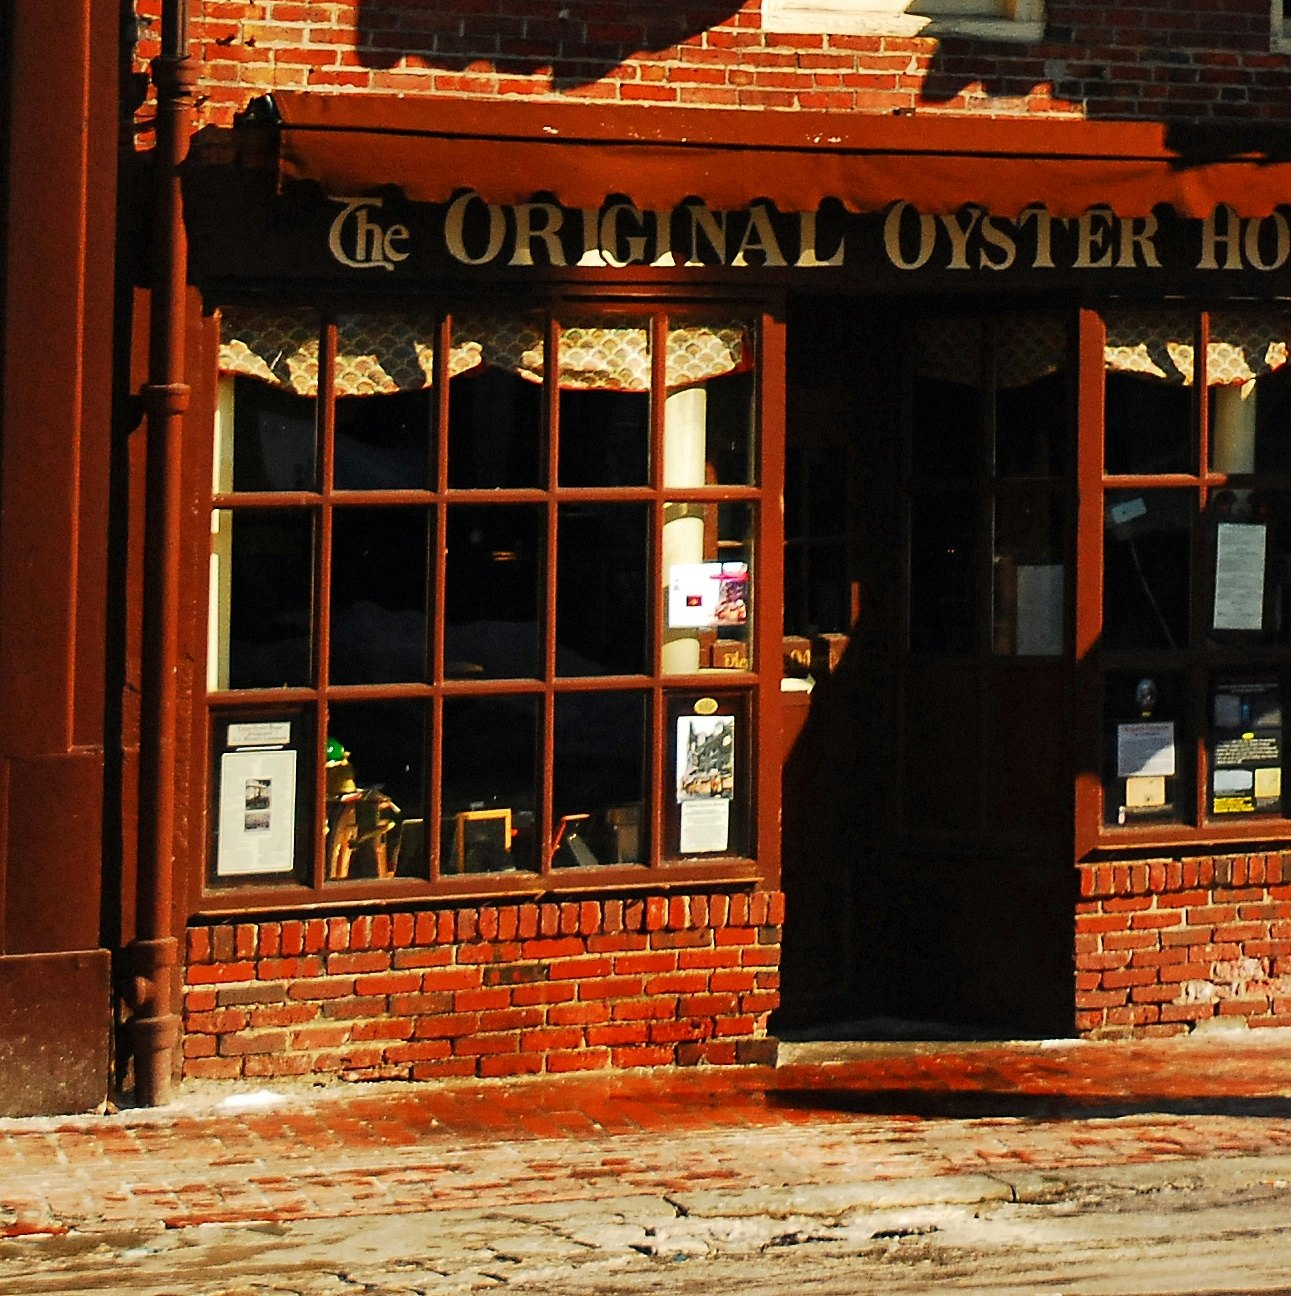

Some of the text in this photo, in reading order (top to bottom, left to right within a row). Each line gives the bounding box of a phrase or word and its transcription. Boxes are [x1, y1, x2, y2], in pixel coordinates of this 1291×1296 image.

[328, 196, 411, 271] The
[443, 190, 845, 268] ORIGINAL
[882, 199, 1163, 271] OYSTER
